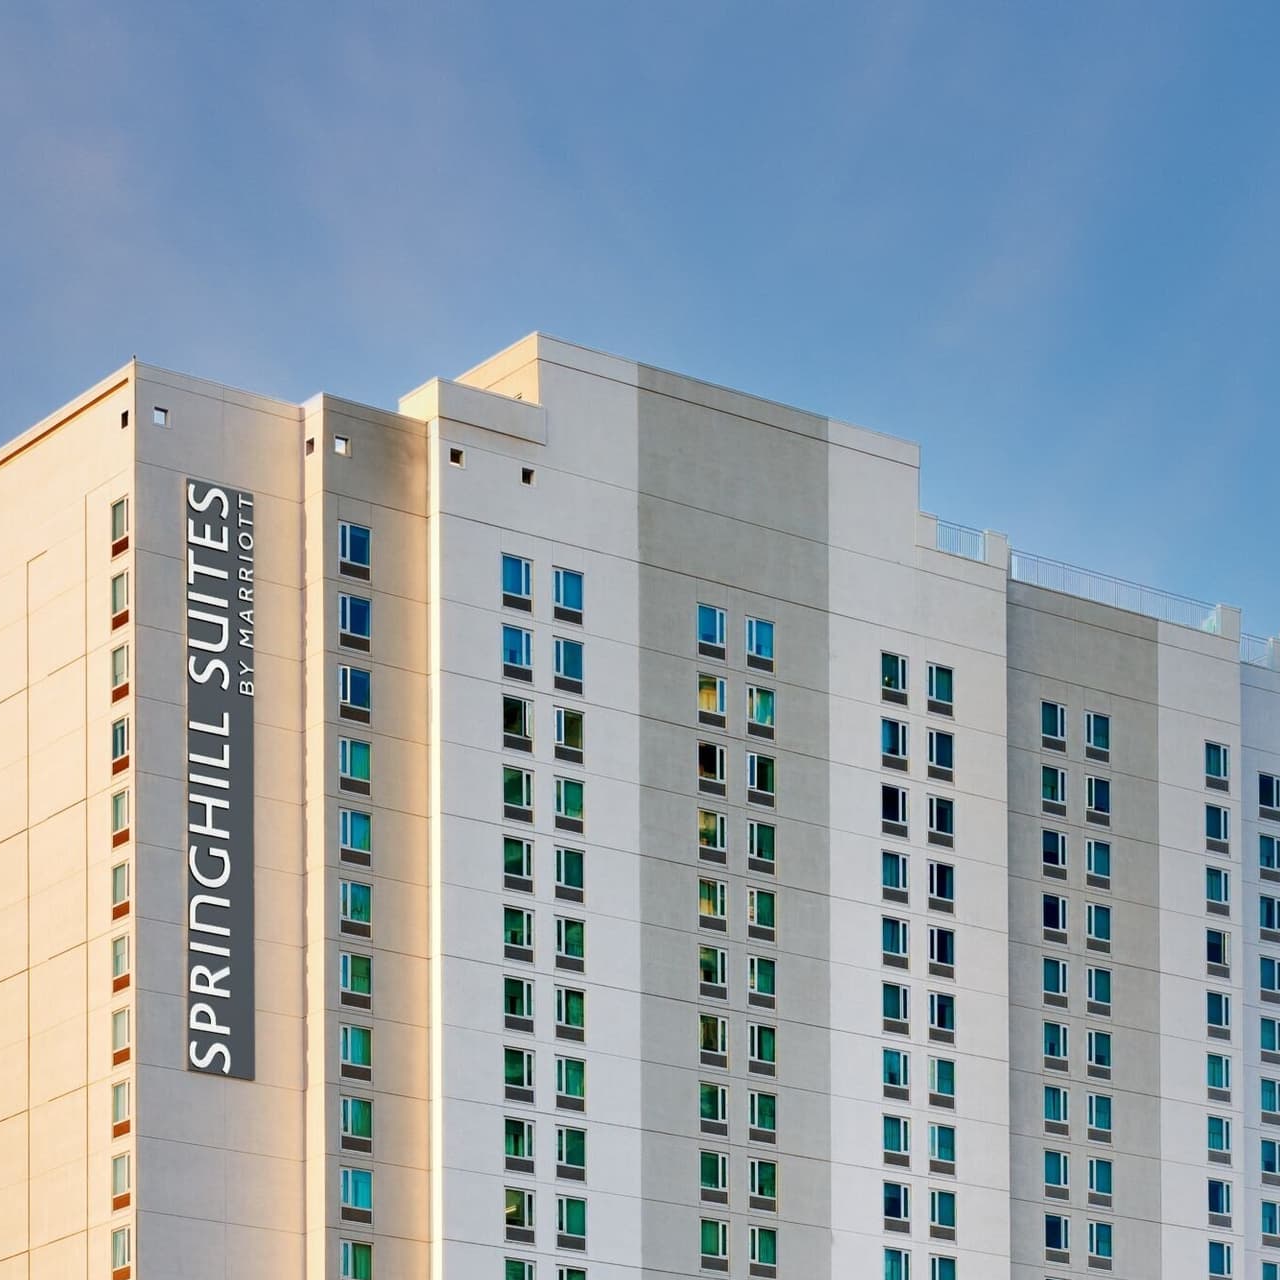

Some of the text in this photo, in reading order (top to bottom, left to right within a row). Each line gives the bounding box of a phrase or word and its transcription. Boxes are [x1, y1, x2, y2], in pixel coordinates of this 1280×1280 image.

[187, 483, 231, 1074] SPRINGHILL SUITES
[238, 493, 255, 697] BY MARRIOTT
